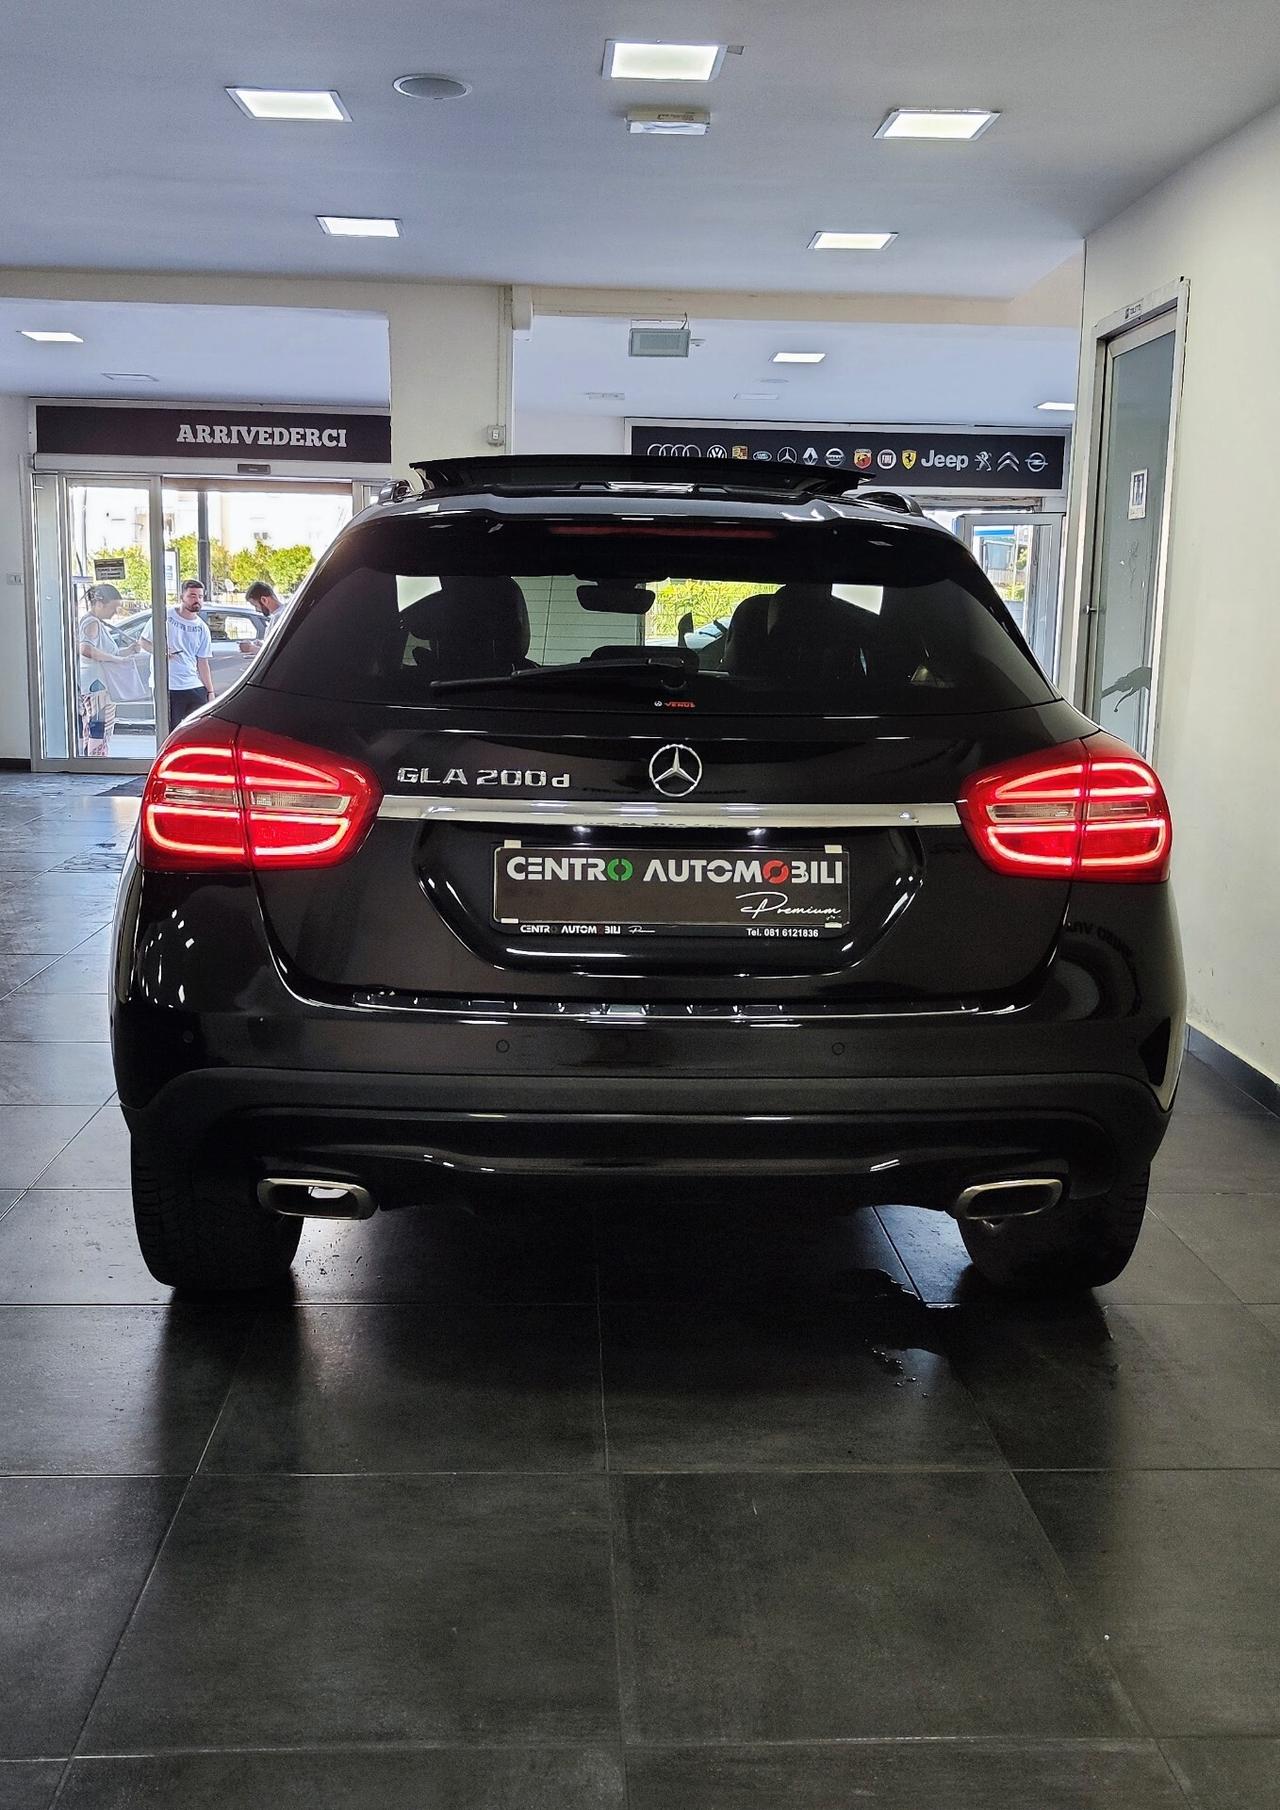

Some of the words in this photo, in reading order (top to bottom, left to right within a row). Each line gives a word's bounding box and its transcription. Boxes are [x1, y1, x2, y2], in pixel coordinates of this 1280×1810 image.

[176, 424, 347, 448] ARRIVEDERCI
[921, 450, 969, 471] Jeep
[397, 767, 468, 785] GLA
[506, 856, 634, 882] CENTRO
[642, 859, 843, 884] AUTOMOBILI
[736, 891, 842, 919] Premium
[520, 924, 557, 934] CENTR
[561, 925, 621, 935] AUTOMBILI
[746, 928, 762, 937] Tel.
[764, 929, 780, 937] 081
[782, 929, 819, 938] 6121836
